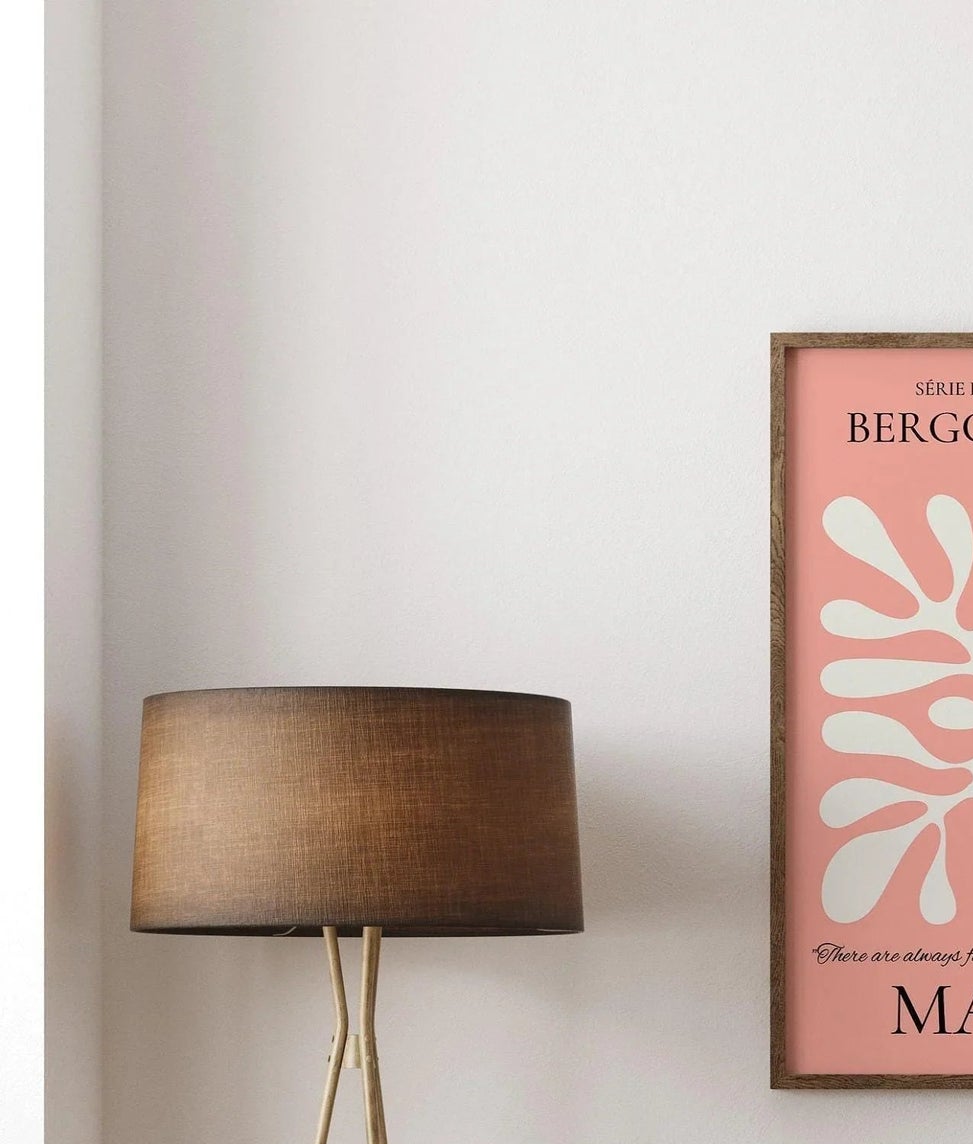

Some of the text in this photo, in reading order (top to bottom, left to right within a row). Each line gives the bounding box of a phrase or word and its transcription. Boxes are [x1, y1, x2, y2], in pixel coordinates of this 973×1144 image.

[915, 378, 966, 396] SÉRIE
[870, 950, 901, 963] are
[902, 947, 963, 967] always
